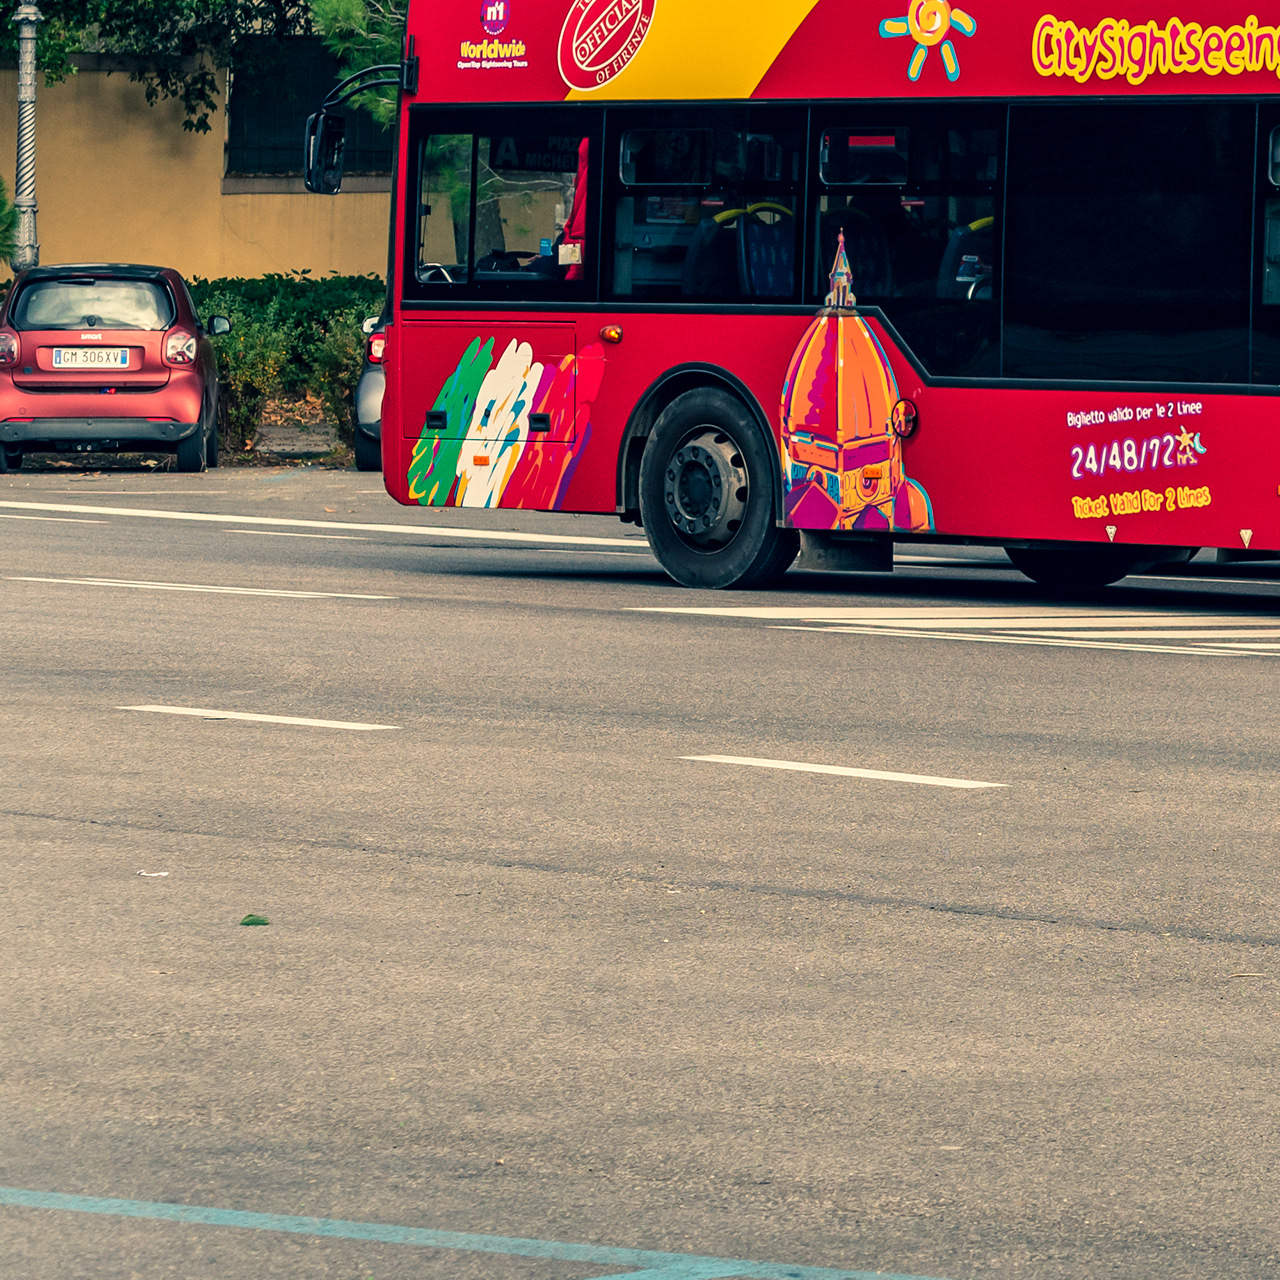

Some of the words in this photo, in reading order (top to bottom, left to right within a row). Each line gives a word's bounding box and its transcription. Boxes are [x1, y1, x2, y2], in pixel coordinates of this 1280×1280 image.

[460, 39, 526, 59] Worldwide
[596, 67, 611, 84] OF
[613, 13, 650, 72] FIRENZE
[513, 60, 528, 68] Tours
[494, 137, 519, 167] A
[548, 136, 578, 151] PIAZ
[525, 152, 577, 169] MICHEL
[63, 351, 77, 363] GM
[82, 351, 119, 363] 306XV
[1066, 410, 1105, 429] Biglietto
[1107, 407, 1134, 422] valido
[1136, 407, 1153, 421] per
[1156, 403, 1165, 418] le
[1167, 402, 1174, 417] 2
[1177, 401, 1202, 415] Linee
[1071, 434, 1175, 479] 24/48/72
[1072, 495, 1109, 518] Ticket
[1110, 490, 1141, 515] Valid
[1165, 487, 1176, 511] 2
[1177, 486, 1212, 508] Lines
